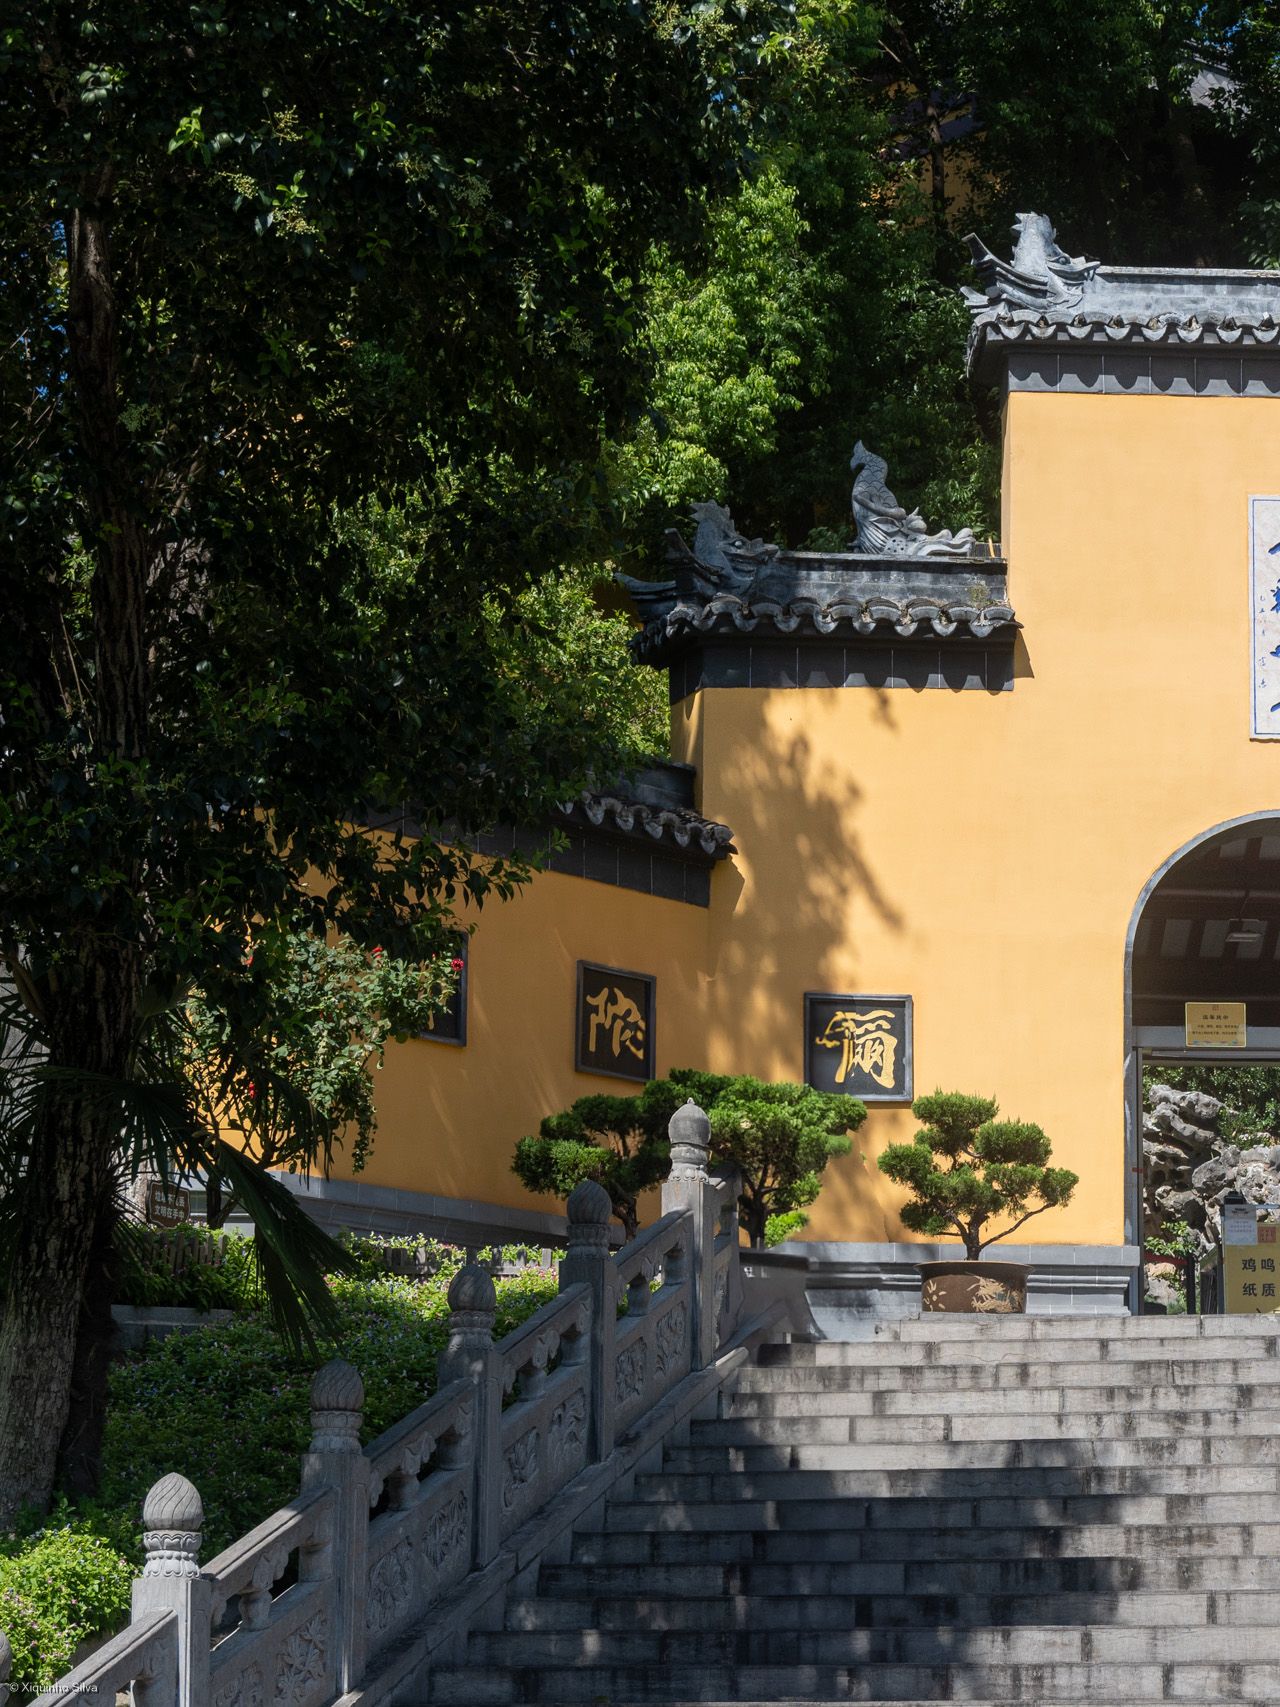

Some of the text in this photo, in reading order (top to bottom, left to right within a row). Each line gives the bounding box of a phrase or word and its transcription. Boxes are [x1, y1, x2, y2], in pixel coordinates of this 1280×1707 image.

[154, 1204, 185, 1221] 文明在手中
